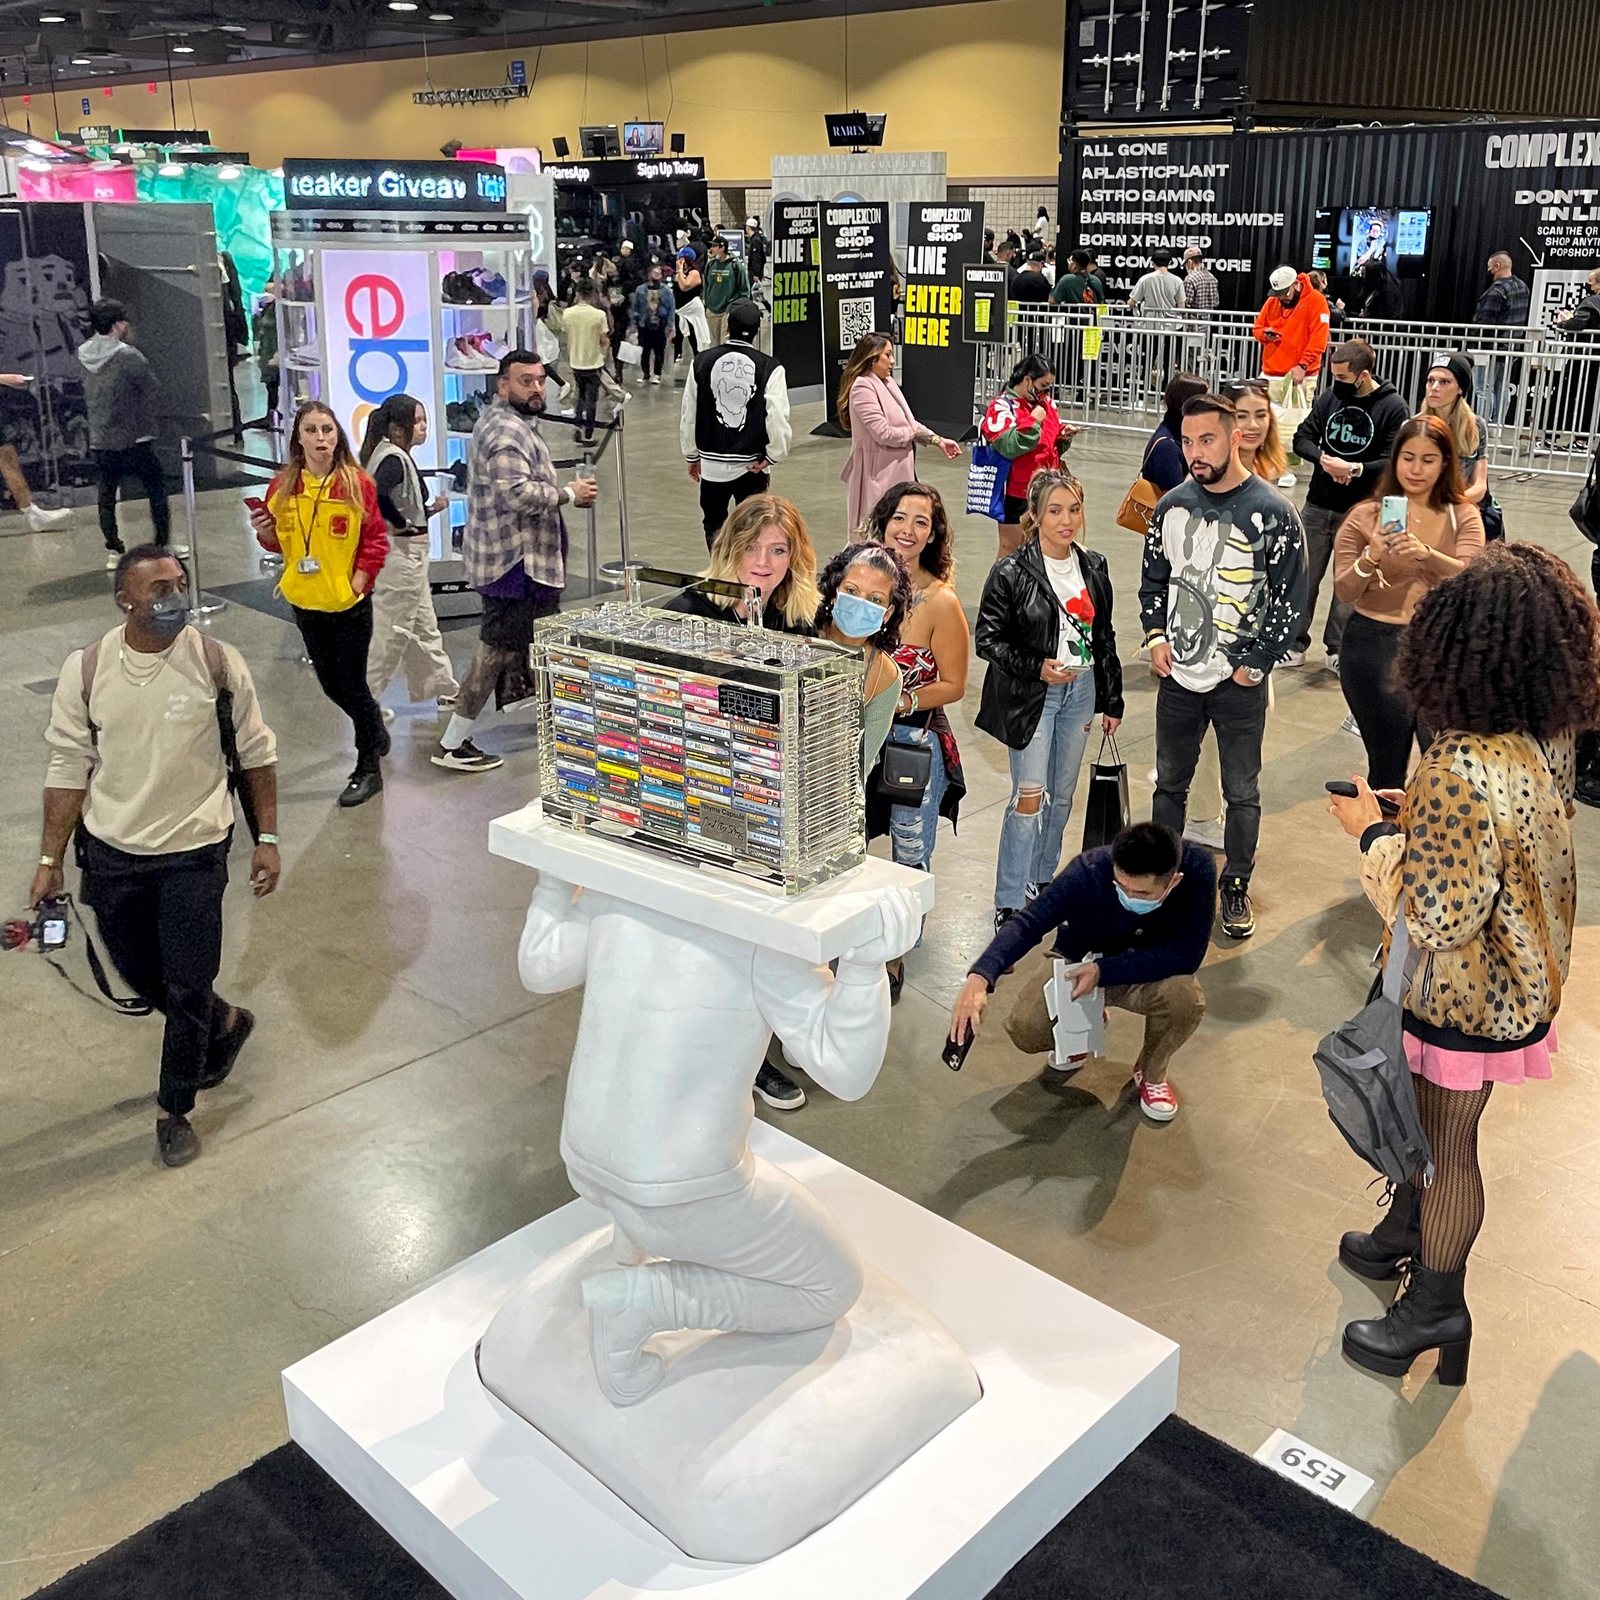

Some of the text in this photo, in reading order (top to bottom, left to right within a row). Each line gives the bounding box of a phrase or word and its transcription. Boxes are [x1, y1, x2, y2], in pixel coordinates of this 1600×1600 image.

[833, 126, 866, 137] RARES
[1083, 143, 1168, 157] ALL GONE
[637, 160, 699, 179] Sign Up Today
[1081, 164, 1230, 179] APLASTICPLANT
[1081, 189, 1215, 203] ASTRO GAMING
[1514, 189, 1599, 205] DON'T
[826, 208, 882, 225] COMPLEXCON
[921, 208, 972, 223] COMPLEXCON
[1080, 211, 1285, 227] BARRIERS WORLDWIDE
[1541, 206, 1570, 221] IN
[788, 226, 816, 235] SHOP
[839, 226, 870, 237] GIFT
[931, 223, 960, 233] GIFT
[1537, 226, 1598, 236] SCAN THE QR
[835, 236, 874, 248] SHOP
[927, 232, 963, 242] SHOP
[1079, 234, 1212, 249] BORN X RAISED
[1545, 237, 1570, 247] SHOP
[774, 239, 804, 264] LINE
[1550, 248, 1594, 257] POPSHOP
[908, 245, 947, 275] LINE
[1199, 258, 1252, 273] TORE
[826, 271, 885, 283] DON'T WAIT
[837, 280, 875, 290] IN LINE!
[905, 284, 962, 315] ENTER
[773, 298, 807, 324] HERE
[904, 316, 950, 347] HERE
[1328, 421, 1367, 446] 76ers
[1280, 1447, 1347, 1491] E59
